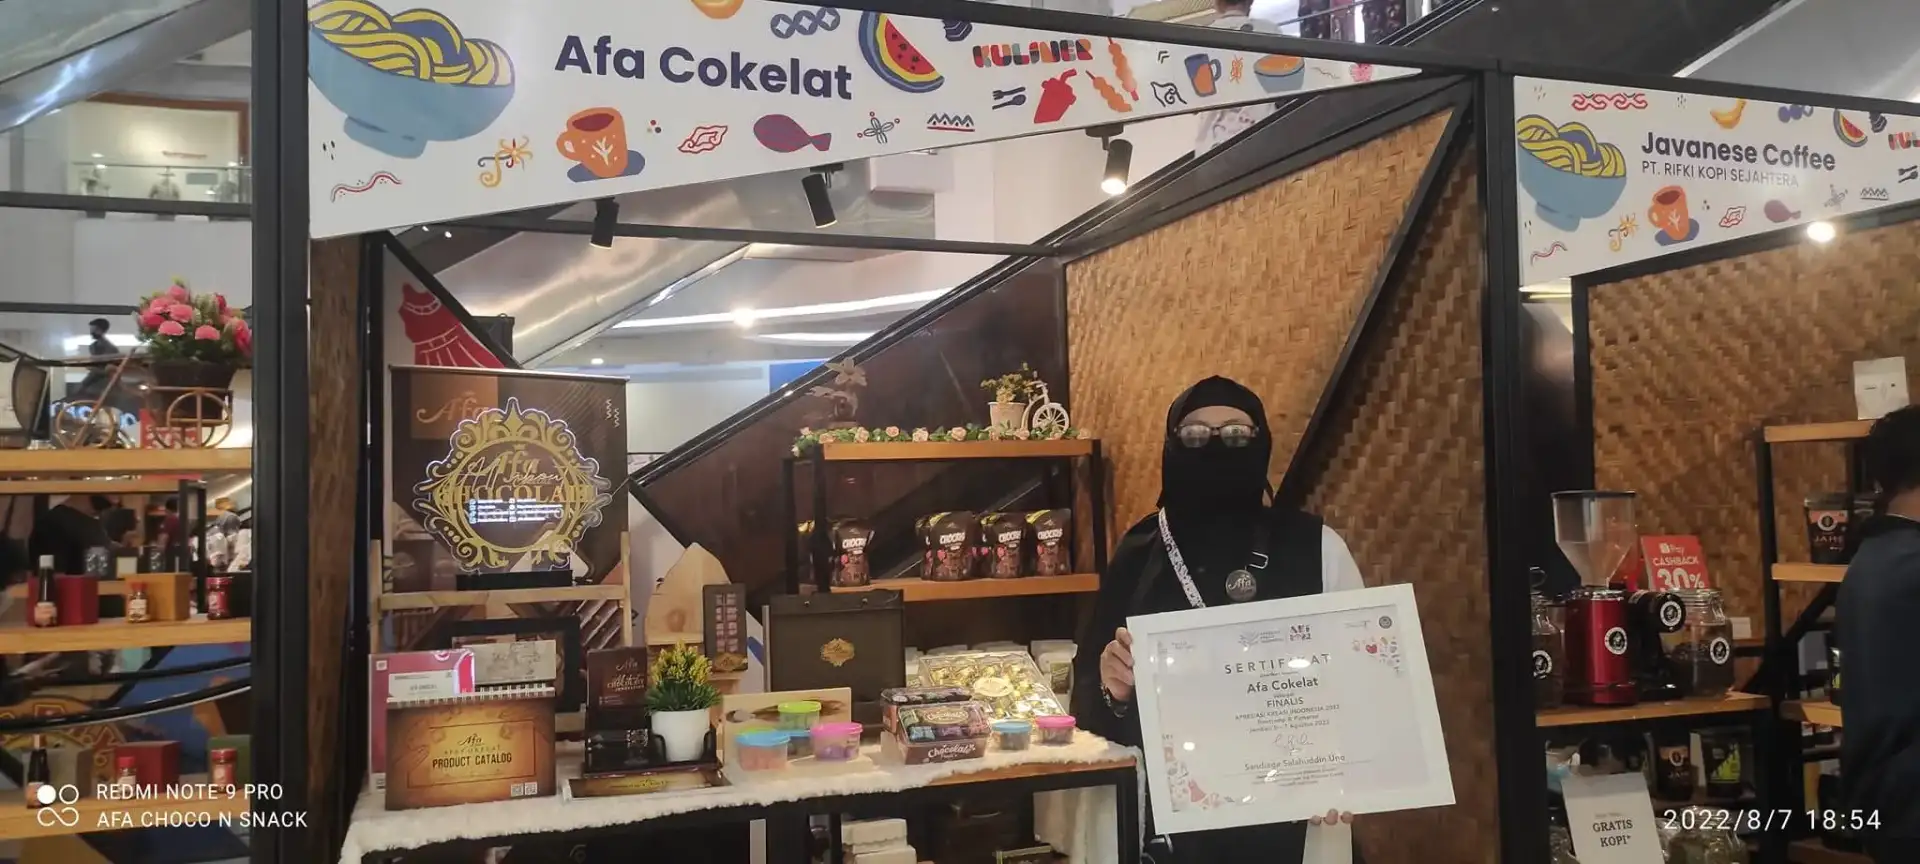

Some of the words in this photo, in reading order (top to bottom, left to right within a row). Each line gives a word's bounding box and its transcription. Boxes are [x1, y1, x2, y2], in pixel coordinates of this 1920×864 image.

[972, 38, 1094, 68] KULINER
[555, 34, 646, 79] Afa
[660, 45, 853, 100] Cokelat
[1641, 131, 1758, 163] Javanese
[1763, 143, 1836, 171] Coffee
[1642, 160, 1661, 175] PT.
[1664, 163, 1694, 178] RIFKI
[1699, 166, 1727, 180] KOPI
[1730, 169, 1799, 187] SEJAHTERA
[1652, 555, 1700, 566] CASHBACK
[1657, 567, 1705, 592] 30%
[1224, 653, 1330, 675] SERTIFAT
[1247, 682, 1269, 694] Afa
[1271, 676, 1319, 691] Cokelat
[1266, 697, 1304, 708] FINALIS
[432, 756, 472, 768] PRODUCT
[475, 752, 513, 766] CATALOG
[1592, 819, 1634, 832] GRATIS
